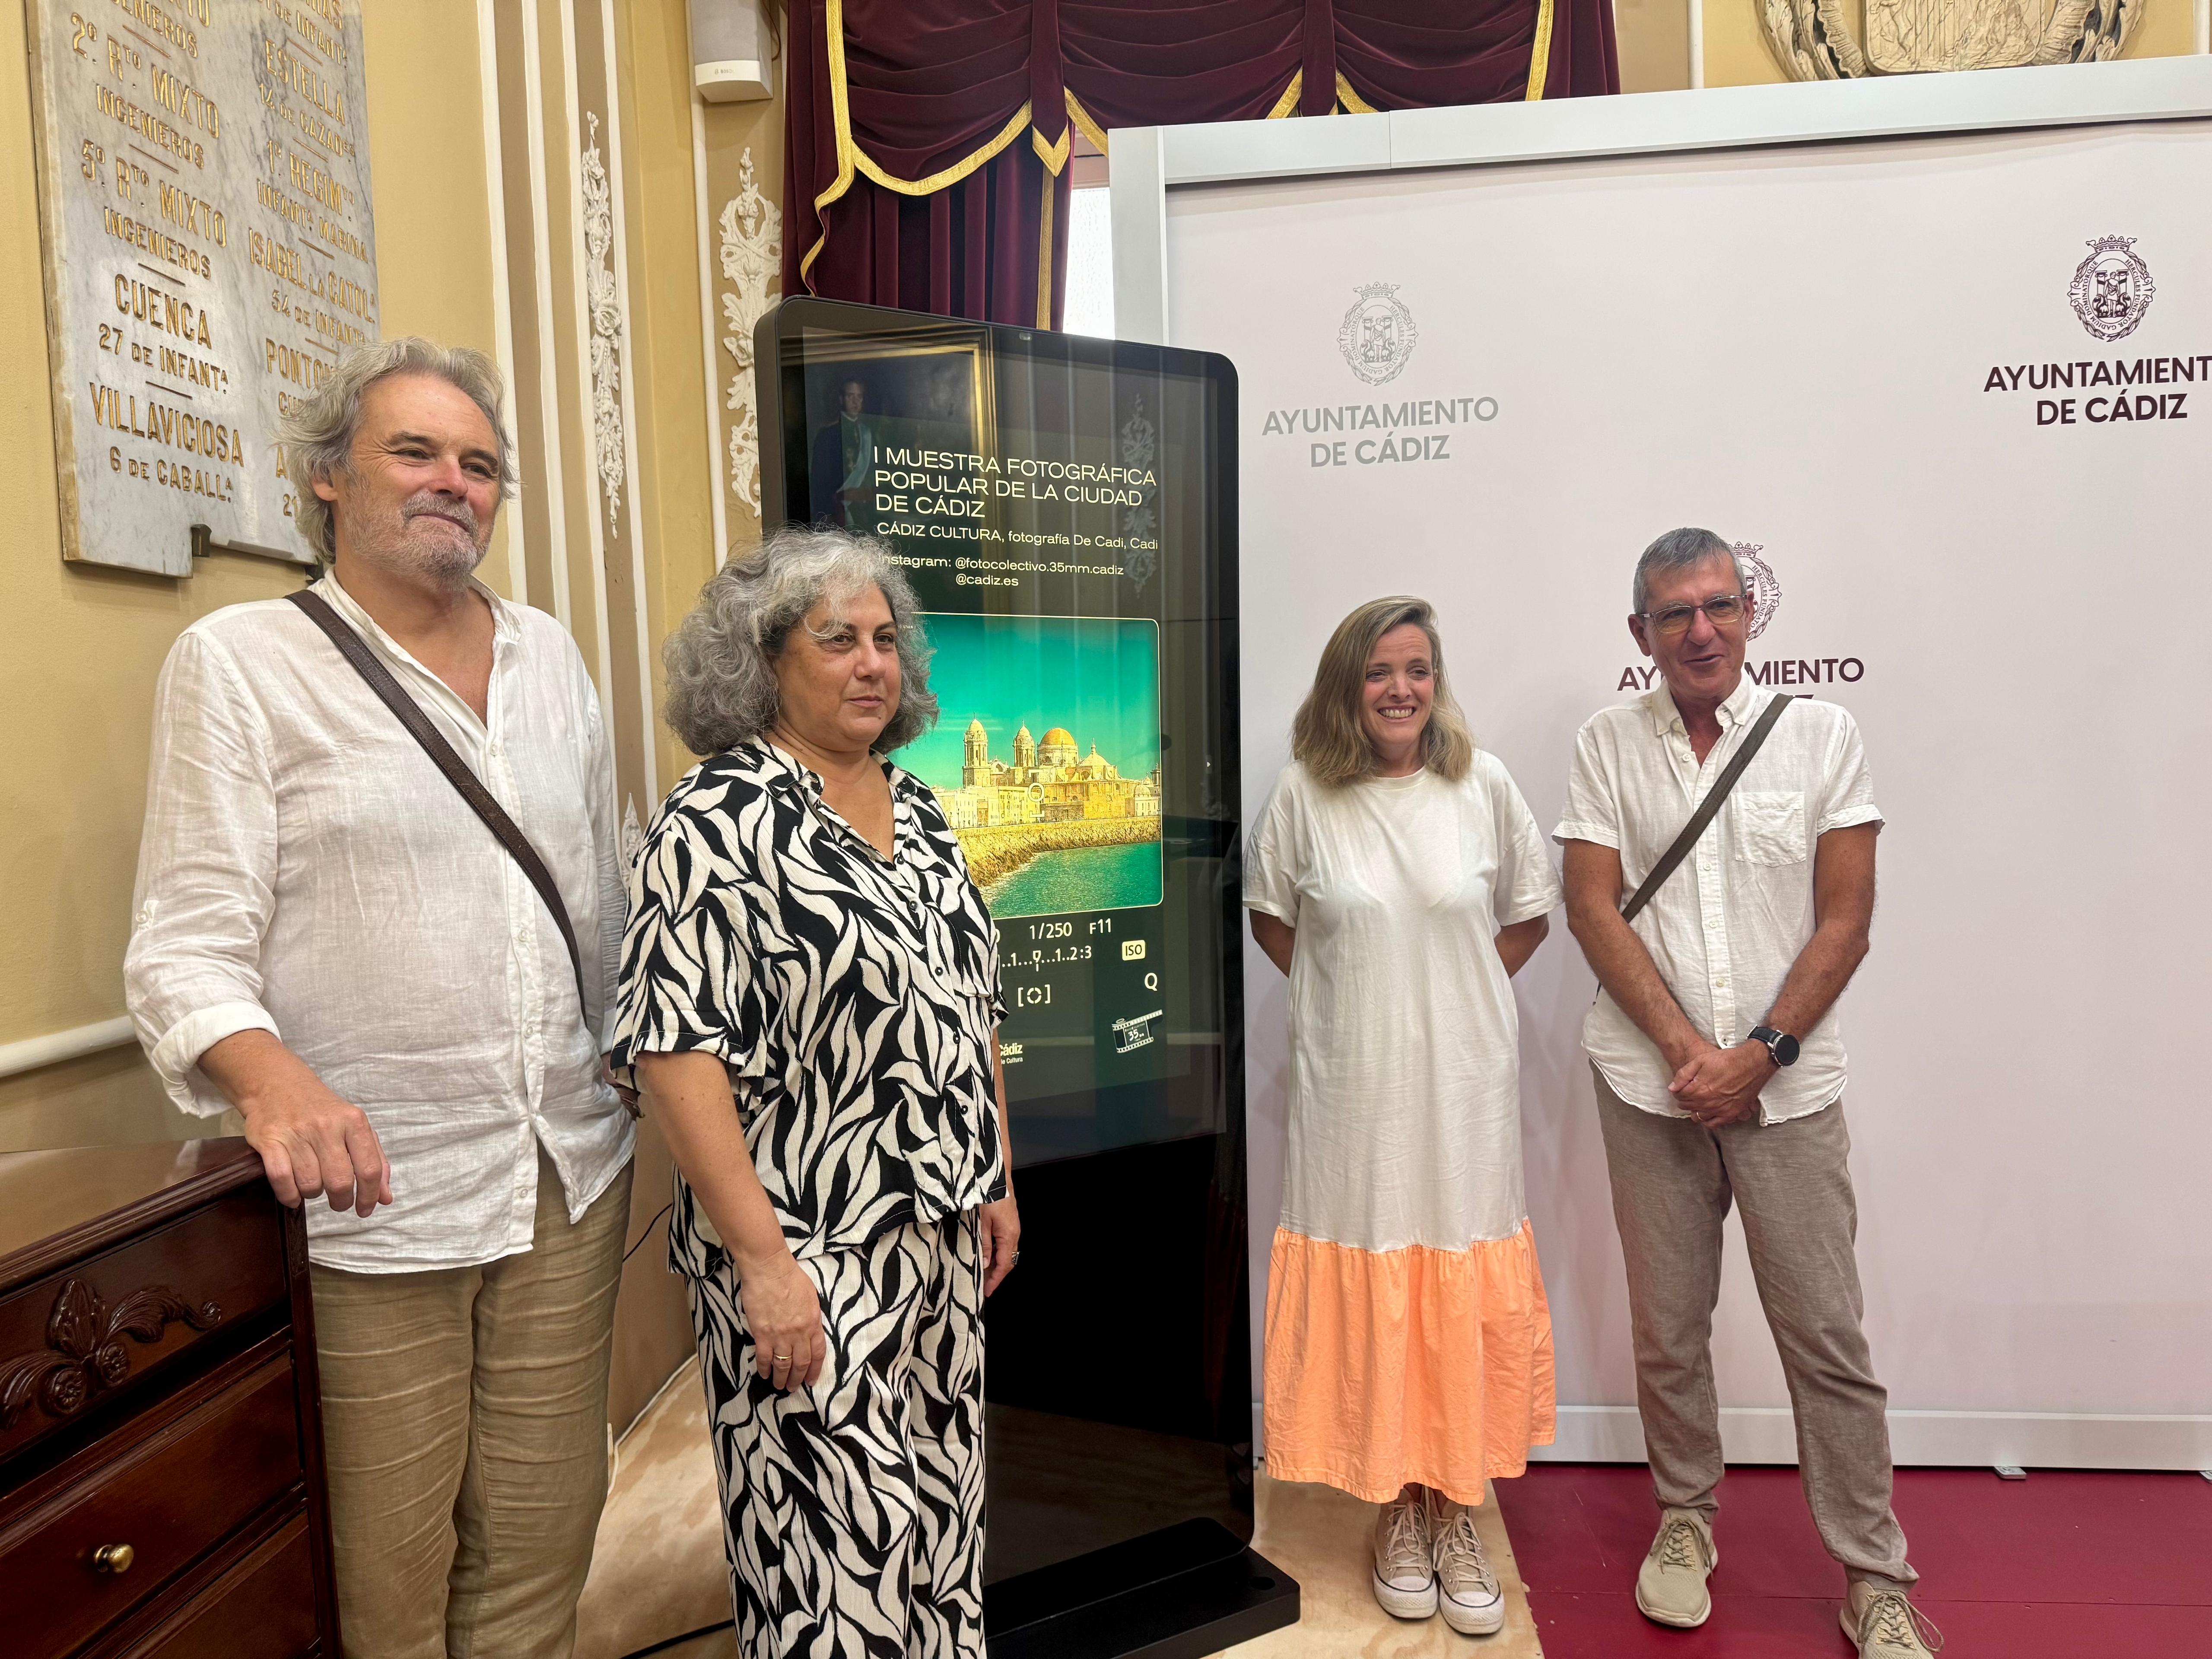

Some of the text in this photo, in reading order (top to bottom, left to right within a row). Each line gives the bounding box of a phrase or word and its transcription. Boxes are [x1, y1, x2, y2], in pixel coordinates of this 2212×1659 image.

[266, 38, 345, 126] ESTELLA
[151, 63, 219, 139] MIXTO
[96, 83, 204, 170] INGENIEROS
[159, 179, 227, 248] MIXTO
[104, 206, 211, 280] INGENIEROS
[319, 216, 368, 264] MARINA
[249, 227, 306, 289] ISABEL
[309, 273, 325, 299] LA
[2125, 259, 2141, 292] HERCULES
[115, 273, 212, 350] CUENCA
[272, 289, 291, 318] 54
[295, 306, 311, 327] DE
[99, 323, 124, 355] 27
[131, 342, 153, 367] DE
[1983, 356, 2212, 392] AYUNTAMIENT
[89, 381, 245, 467] VILLAVICIOSA
[1262, 397, 1499, 435] AYUNTAMIENTO
[2037, 388, 2187, 426] DE CÁDIZ
[110, 446, 121, 473] 6
[128, 458, 149, 481] DE
[874, 446, 1157, 486] I MUESTRA FOTOGRÁFICA
[1311, 431, 1450, 467] DE CÁDIZ
[874, 470, 1142, 506] POPULAR DE LA CIUDAD
[875, 493, 985, 518] DE CÁDIZ
[877, 521, 1158, 550] CÁDIZ CULTURA, fotografía De Cadi, Cadi
[955, 557, 1125, 575] @fotocolectivo.35mm.cadiz
[955, 573, 1019, 587] @cadiz.es
[1751, 599, 1767, 628] FUNDATO
[1617, 658, 1864, 691] AYMIENTO
[1029, 918, 1111, 940] 1/250 F11
[1125, 944, 1142, 956] ISO
[1144, 972, 1158, 992] Q
